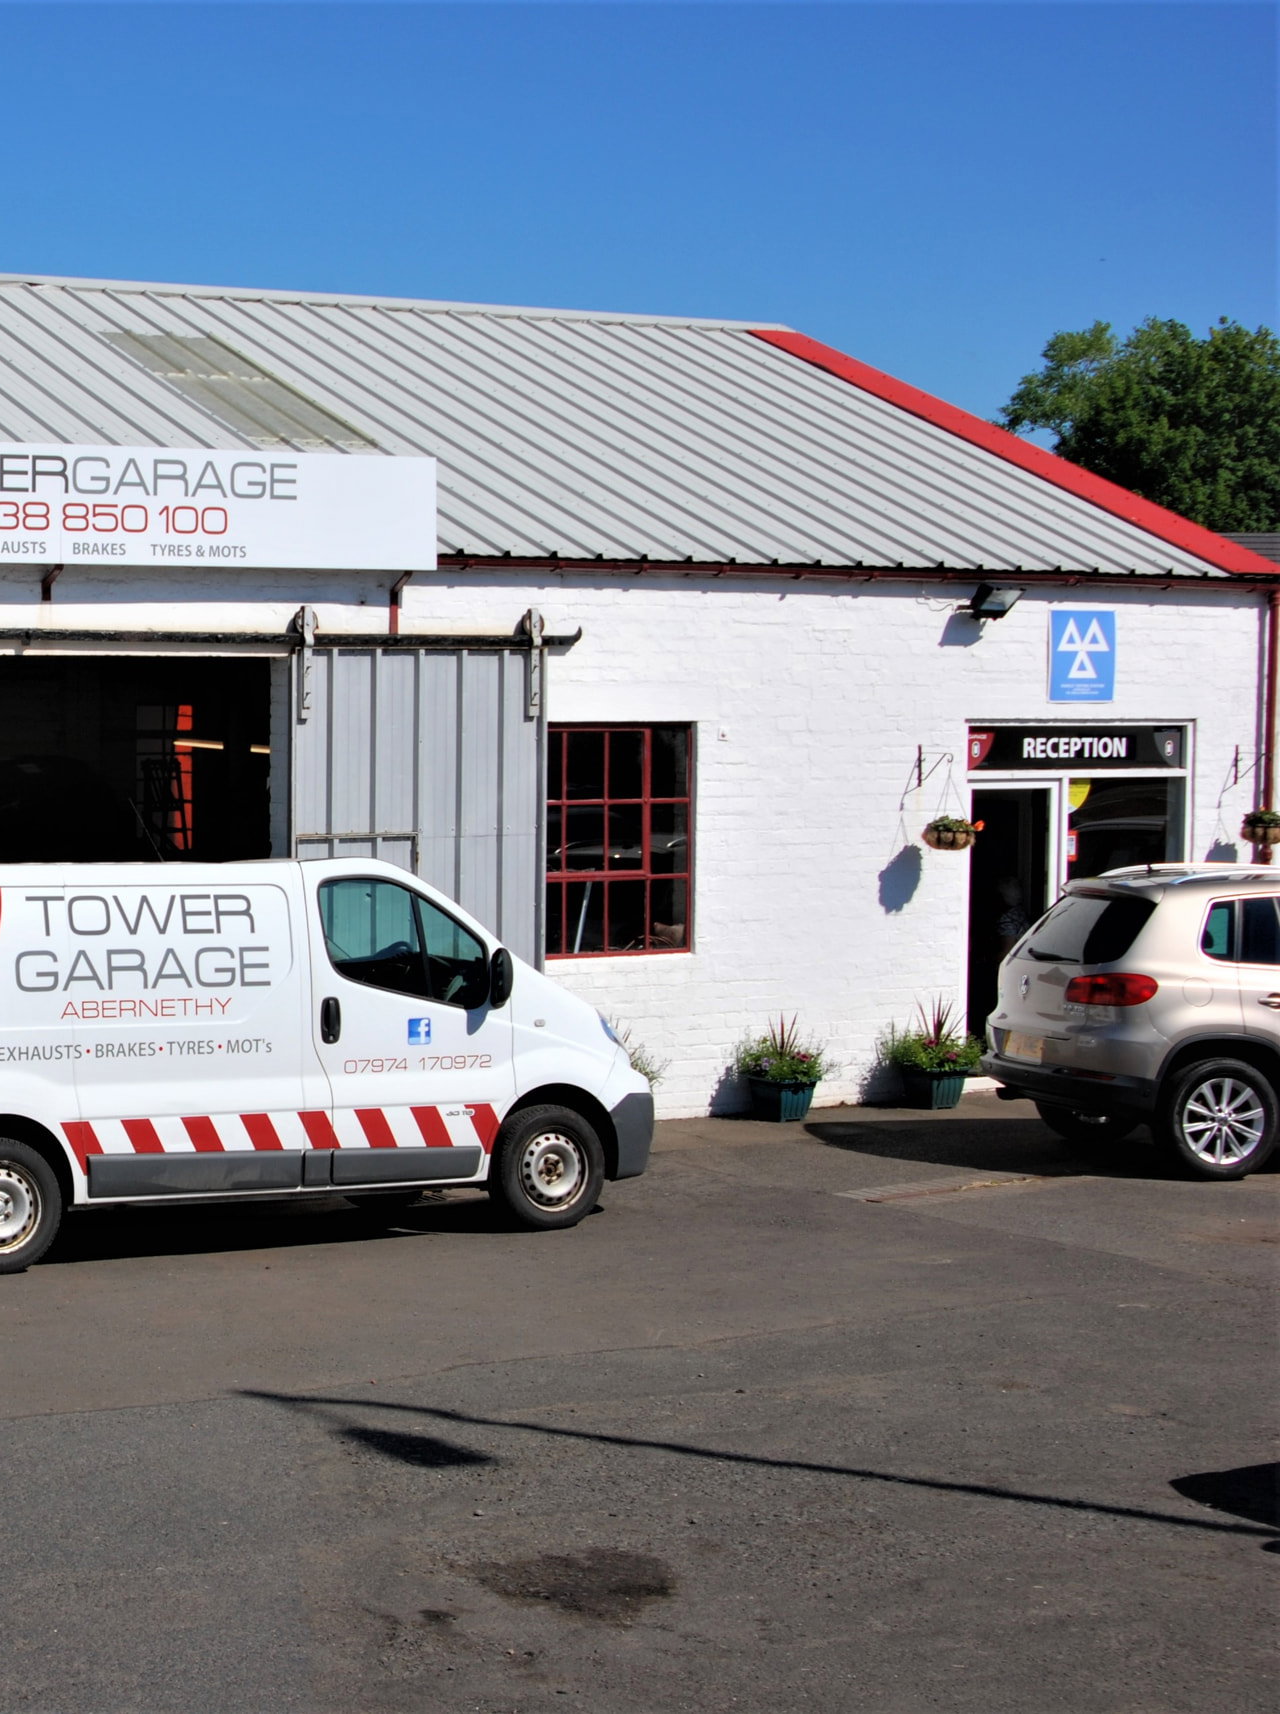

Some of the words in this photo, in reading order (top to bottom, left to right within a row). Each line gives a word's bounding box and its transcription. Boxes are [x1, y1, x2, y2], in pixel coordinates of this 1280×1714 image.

[61, 502, 149, 534] 850
[158, 505, 229, 536] 100
[72, 542, 126, 556] BRAKES
[150, 543, 192, 557] TYRES
[195, 545, 206, 558] &
[208, 545, 247, 559] MOTS
[1022, 736, 1127, 760] RECEPTION
[24, 893, 256, 937] TOWER
[14, 945, 272, 993] GARAGE
[60, 997, 233, 1020] ABERNETHY
[95, 1041, 156, 1059] BRAKES
[166, 1039, 215, 1056] TYRES
[226, 1037, 273, 1055] MOT's
[344, 1058, 408, 1074] 07974
[418, 1054, 492, 1071] 170972
